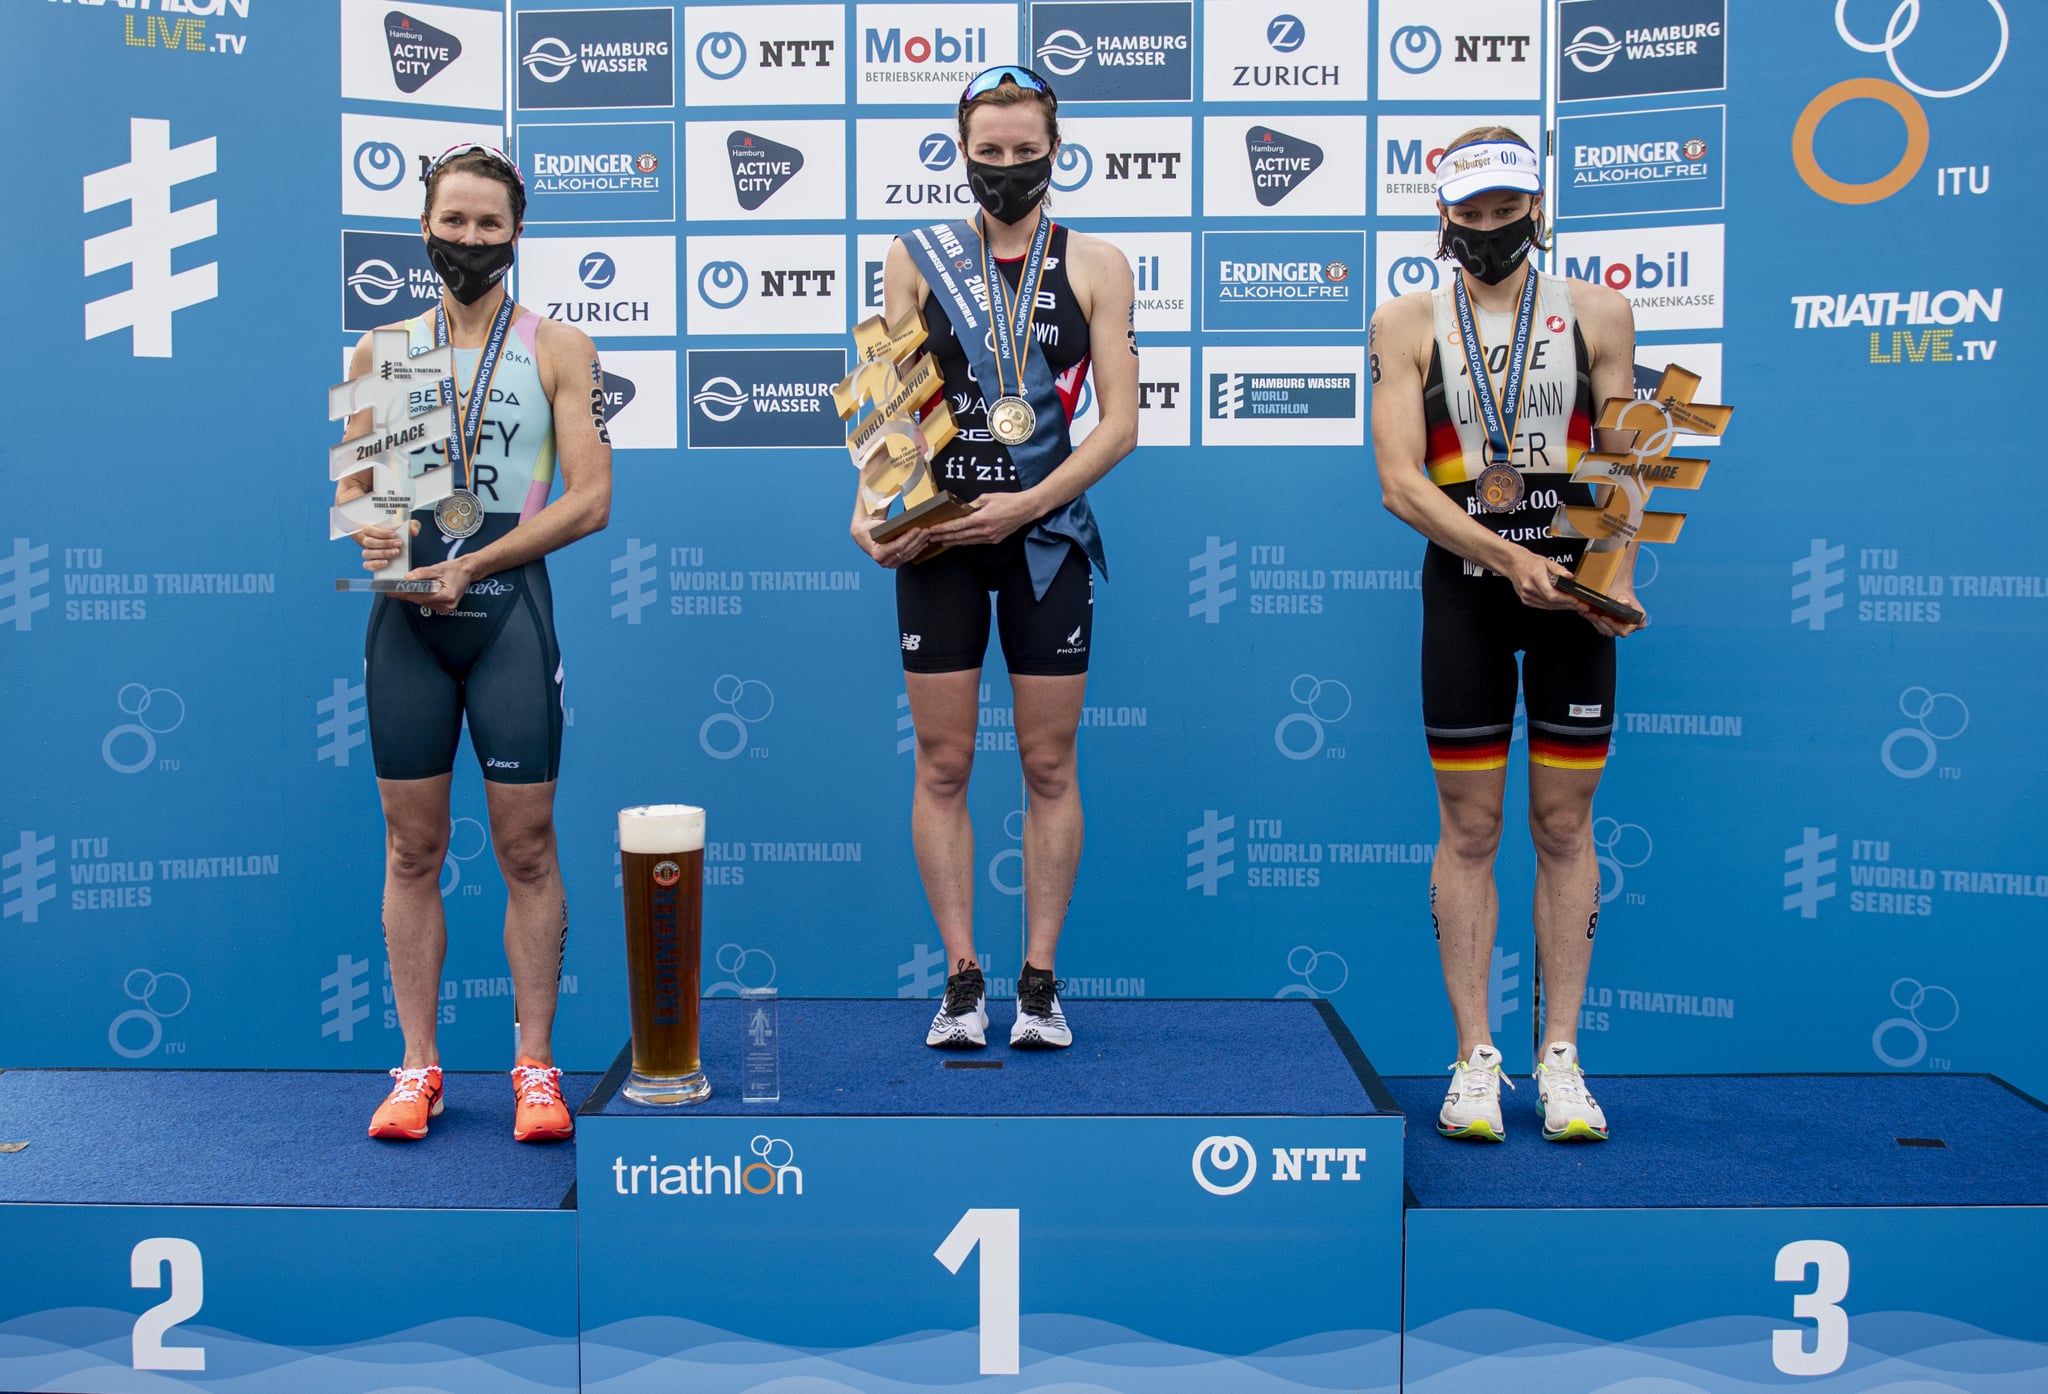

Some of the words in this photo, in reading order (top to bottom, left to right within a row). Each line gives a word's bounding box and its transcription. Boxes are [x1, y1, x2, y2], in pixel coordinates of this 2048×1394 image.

[389, 29, 423, 42] Hamburg
[1097, 35, 1187, 51] HAMBURG
[1625, 22, 1721, 44] HAMBURG
[393, 43, 449, 62] ACTIVE
[580, 41, 668, 57] HAMBURG
[760, 40, 834, 67] NTT
[865, 27, 986, 63] Mobil
[1454, 36, 1530, 62] NTT
[1626, 41, 1697, 60] WASSER
[396, 59, 431, 76] CITY
[580, 58, 648, 73] WASSER
[1098, 51, 1166, 66] WASSER
[1232, 66, 1339, 86] ZURICH
[732, 149, 765, 158] Hamburg
[1251, 145, 1284, 154] Hamburg
[1574, 141, 1681, 170] ERDINGER
[534, 152, 634, 177] ERDINGER
[736, 162, 791, 176] ACTIVE
[1105, 152, 1180, 179] NTT
[1254, 158, 1310, 171] ACTIVE
[1573, 163, 1707, 183] ALKOHOLFREI
[534, 177, 659, 191] ALKOHOLFREI
[738, 178, 773, 192] CITY
[1257, 173, 1292, 187] CITY
[1938, 165, 1989, 196] ITU
[1030, 232, 1045, 266] TRIATHLON
[1024, 266, 1036, 293] WORLD
[1219, 260, 1324, 284] ERDINGER
[1565, 251, 1689, 288] Mobil
[761, 270, 835, 297] NTT
[1219, 285, 1349, 298] ALKOHOLFREI
[1521, 276, 1535, 314] TRIATHLON
[547, 301, 649, 322] ZURICH
[1015, 293, 1031, 336] CHAMPION
[1790, 288, 2003, 329] TRIATHLON
[494, 306, 513, 342] TRIATHLON
[991, 282, 1001, 311] WORLD
[996, 311, 1011, 360] CHAMPION
[1517, 314, 1531, 342] WORLD
[484, 341, 499, 367] WORLD
[1458, 294, 1471, 331] TRIATHLON
[1465, 331, 1479, 360] WORLD
[1472, 361, 1499, 433] CHAMPIONSHIPS
[1251, 377, 1305, 388] HAMBURG
[1307, 378, 1350, 389] WASSER
[1505, 343, 1525, 414] CHAMPIONSHIPS
[465, 367, 489, 437] CHAMPIONSHIPS
[753, 399, 820, 413] WASSER
[1251, 390, 1289, 401] WORLD
[854, 415, 886, 450] WORLD
[885, 366, 931, 418] CHAMPION
[1251, 403, 1309, 414] TRIATHLON
[356, 439, 382, 461] 2nd
[385, 423, 425, 450] PLACE
[1608, 462, 1635, 477] 3rd
[1637, 464, 1679, 480] PLACE
[1498, 525, 1553, 541] ZURIC
[65, 548, 102, 569] ITU
[671, 548, 703, 567] ITU
[1251, 546, 1284, 565] ITU
[1860, 549, 1898, 570] ITU
[64, 574, 148, 594] WORLD
[153, 573, 275, 594] TRIATHLON
[669, 571, 744, 591] WORLD
[749, 571, 861, 590] TRIATHLON
[1249, 570, 1325, 590] WORLD
[1858, 575, 1943, 596] WORLD
[1950, 576, 2048, 597] TRIATHL
[65, 600, 146, 621] SERIES
[671, 595, 742, 615] SERIES
[1250, 594, 1323, 614] SERIES
[1858, 601, 1941, 623] SERIES
[1624, 713, 1742, 736] TRIATHLON
[750, 748, 769, 759] ITU
[1326, 748, 1345, 758] ITU
[159, 759, 180, 771] ITU
[495, 760, 520, 769] asics
[1939, 767, 1961, 779] ITU
[1249, 819, 1282, 839] ITU
[71, 837, 109, 859] ITU
[751, 842, 862, 862] TRIATHLON
[1247, 844, 1322, 863] WORLD
[1852, 840, 1890, 862] ITU
[70, 861, 154, 885] WORLD
[159, 854, 280, 880] TRIATHLON
[1247, 868, 1320, 887] SERIES
[1850, 865, 1935, 890] WORLD
[72, 886, 152, 910] SERIES
[463, 885, 481, 895] ITU
[1625, 893, 1645, 905] ITU
[1850, 891, 1932, 916] SERIES
[653, 885, 680, 1025] ERDINGER
[1618, 989, 1734, 1019] TRIATHLON
[165, 1042, 186, 1055] ITU
[1930, 1058, 1950, 1070] ITU
[612, 1155, 803, 1196] triathlon
[1272, 1148, 1366, 1182] NTT
[933, 1208, 1020, 1375] 1
[130, 1237, 205, 1371] 2
[1772, 1239, 1850, 1376] 3
